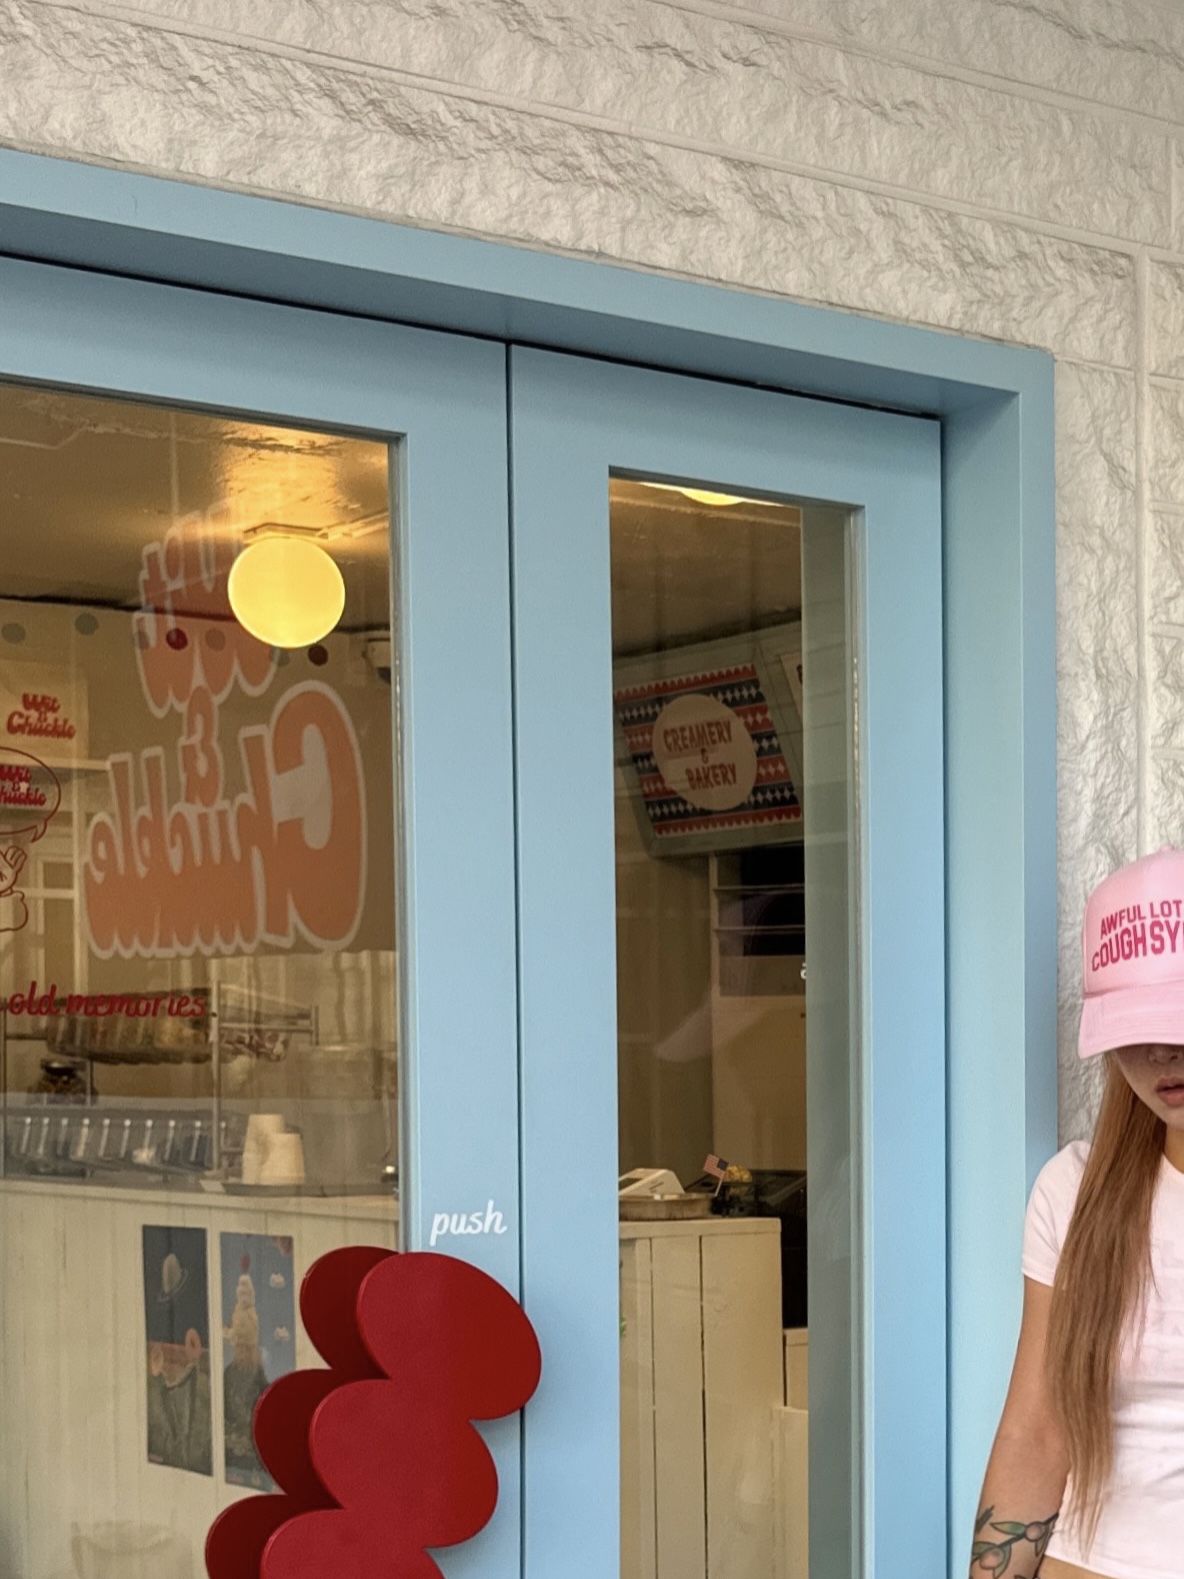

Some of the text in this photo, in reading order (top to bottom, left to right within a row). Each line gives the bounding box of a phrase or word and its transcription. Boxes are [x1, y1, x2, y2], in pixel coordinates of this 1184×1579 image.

[6, 710, 76, 739] Chuckle
[663, 720, 732, 753] CREAMERY
[685, 763, 737, 790] BAKERY
[0, 785, 46, 806] huckle
[1100, 905, 1146, 940] AWFUL
[1149, 900, 1183, 919] LOT
[1091, 924, 1148, 972] COUGH
[8, 980, 61, 1016] old
[428, 1199, 508, 1247] push
